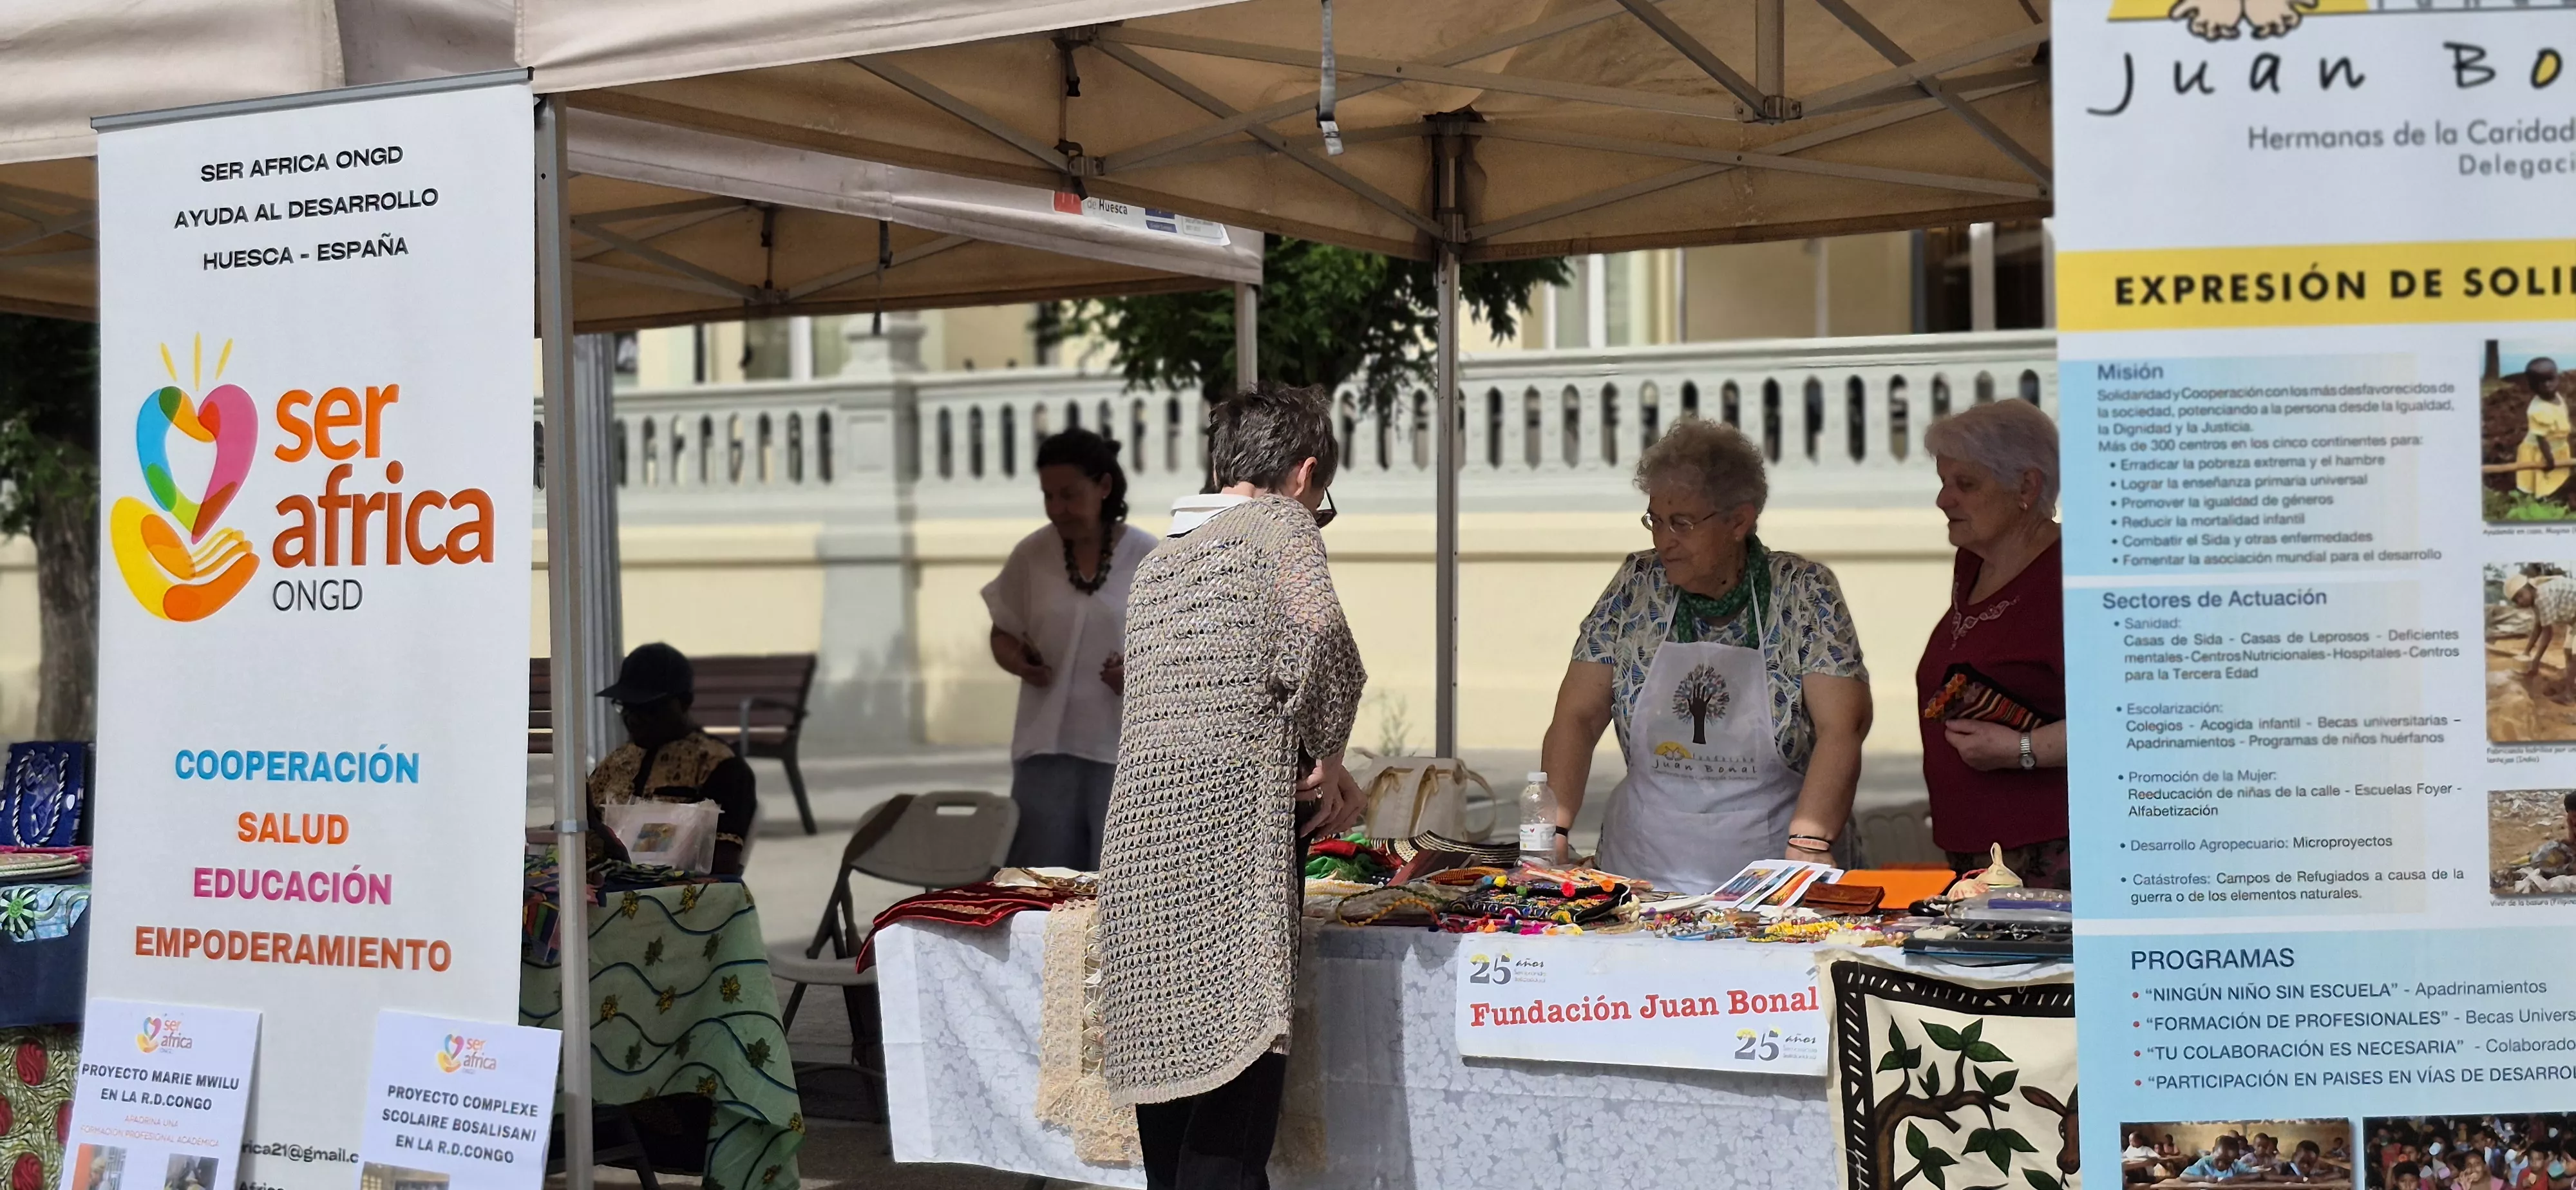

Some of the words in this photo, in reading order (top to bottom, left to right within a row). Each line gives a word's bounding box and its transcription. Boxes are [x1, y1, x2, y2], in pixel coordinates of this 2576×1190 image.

[2087, 52, 2365, 116] Juan
[2249, 126, 2384, 151] Hermanas
[2393, 121, 2425, 146] de
[2436, 120, 2458, 145] la
[2467, 117, 2575, 145] Caridad
[201, 162, 243, 182] SER
[250, 153, 329, 177] AFRICA
[336, 146, 402, 169] ONGD
[175, 206, 249, 229] AYUDA
[254, 203, 281, 222] AL
[289, 189, 438, 218] DESARROLLO
[1099, 199, 1128, 214] Huesca
[204, 247, 294, 270] HUESCA
[317, 233, 408, 261] ESPAÑA
[2116, 263, 2365, 305] EXPRESIÓN
[2391, 269, 2442, 298] DE
[2463, 266, 2576, 297] SOLI
[2098, 363, 2163, 381] Misión
[274, 384, 399, 462] ser
[2121, 479, 2163, 493] Lograr
[2167, 477, 2179, 489] la
[2182, 476, 2251, 489] enseñanza
[2255, 477, 2307, 490] primaria
[2310, 474, 2367, 486] universal
[272, 460, 494, 568] africa
[2121, 496, 2184, 509] Promover
[2188, 496, 2200, 508] la
[2204, 495, 2259, 511] igualdad
[2262, 495, 2278, 506] de
[2282, 495, 2334, 509] géneros
[2122, 516, 2172, 528] Reducir
[2176, 516, 2188, 527] la
[2191, 515, 2259, 527] mortalidad
[2263, 513, 2305, 525] infantil
[2122, 535, 2183, 548] Combatir
[2186, 534, 2197, 546] el
[2202, 533, 2230, 545] Sida
[2234, 536, 2241, 548] y
[2244, 534, 2278, 545] otras
[2280, 531, 2373, 544] enfermedades
[273, 580, 363, 611] ONGD
[2103, 592, 2191, 610] Sectores
[2197, 590, 2222, 608] de
[2228, 588, 2327, 607] Actuación
[2125, 617, 2180, 629] Sanidad:
[2127, 702, 2222, 715] Escolarización:
[175, 744, 419, 783] COOPERACIÓN
[1652, 760, 1692, 771] Juan
[2129, 770, 2199, 783] Promoción
[2202, 771, 2219, 782] de
[2223, 771, 2233, 782] la
[2238, 770, 2276, 783] Mujer:
[2128, 788, 2212, 800] Reeducación
[2217, 788, 2233, 798] de
[2237, 787, 2271, 798] niñas
[2275, 786, 2291, 797] de
[2296, 786, 2307, 797] la
[2311, 785, 2340, 797] calle
[2355, 784, 2412, 796] Escuelas
[2417, 783, 2452, 797] Foyer
[2129, 804, 2218, 817] Alfabetización
[238, 812, 348, 844] SALUD
[2131, 839, 2195, 851] Desarrollo
[2199, 839, 2288, 853] Agropecuario:
[2293, 836, 2392, 850] Microproyectos
[194, 865, 392, 905] EDUCACIÓN
[2133, 873, 2210, 885] Catástrofes:
[2217, 872, 2270, 886] Campos
[2276, 872, 2291, 883] de
[2297, 870, 2369, 885] Refugiados
[2375, 872, 2382, 881] a
[2388, 871, 2426, 880] causa
[2432, 869, 2448, 880] de
[2454, 869, 2464, 879] la
[2131, 893, 2172, 905] guerra
[2176, 892, 2184, 902] o
[2188, 891, 2204, 902] de
[2209, 891, 2226, 902] los
[2231, 889, 2297, 901] elementos
[2300, 887, 2362, 900] naturales.
[135, 926, 451, 972] EMPODERAMIENTO
[2132, 948, 2294, 970] PROGRAMAS
[1470, 954, 1511, 985] 25
[1515, 958, 1544, 968] años
[2146, 983, 2221, 1001] “NINGÚN
[2228, 983, 2270, 1000] NIÑO
[2277, 985, 2304, 999] SIN
[2311, 983, 2398, 999] ESCUELA”
[2416, 980, 2546, 999] Apadrinamientos
[1470, 995, 1631, 1026] Fundación
[1640, 994, 1719, 1018] Juan
[1727, 987, 1819, 1014] Bonal
[164, 1019, 181, 1031] ser
[2146, 1012, 2260, 1031] “FORMACIÓN
[2268, 1014, 2289, 1028] DE
[2296, 1011, 2448, 1028] PROFESIONALES”
[2467, 1010, 2514, 1024] Becas
[160, 1032, 193, 1049] africa
[466, 1038, 486, 1050] ser
[1734, 1030, 1779, 1061] 25
[1785, 1033, 1817, 1044] años
[2148, 1046, 2177, 1061] “TU
[2184, 1039, 2324, 1060] COLABORACIÓN
[2330, 1043, 2351, 1057] ES
[2358, 1039, 2463, 1055] NECESARIA”
[2486, 1037, 2576, 1052] Colaborado
[464, 1052, 497, 1070] africa
[82, 1064, 148, 1081] PROYECTO
[152, 1070, 193, 1085] MARIE
[196, 1075, 239, 1090] MWILU
[2148, 1070, 2287, 1089] “PARTICIPACIÓN
[2295, 1072, 2316, 1086] EN
[2324, 1070, 2383, 1085] PAISES
[2389, 1070, 2411, 1084] EN
[2417, 1065, 2455, 1084] VÍAS
[2461, 1068, 2483, 1082] DE
[101, 1088, 118, 1100] EN
[122, 1090, 137, 1102] LA
[141, 1092, 211, 1110] R.D.CONGO
[388, 1085, 459, 1106] PROYECTO
[463, 1095, 538, 1117] COMPLEXE
[124, 1115, 160, 1126] APADRINA
[382, 1108, 449, 1129] SCOLAIRE
[452, 1119, 536, 1141] BOSALISANI
[395, 1135, 414, 1148] EN
[417, 1138, 433, 1151] LA
[438, 1141, 513, 1163] R.D.CONGO
